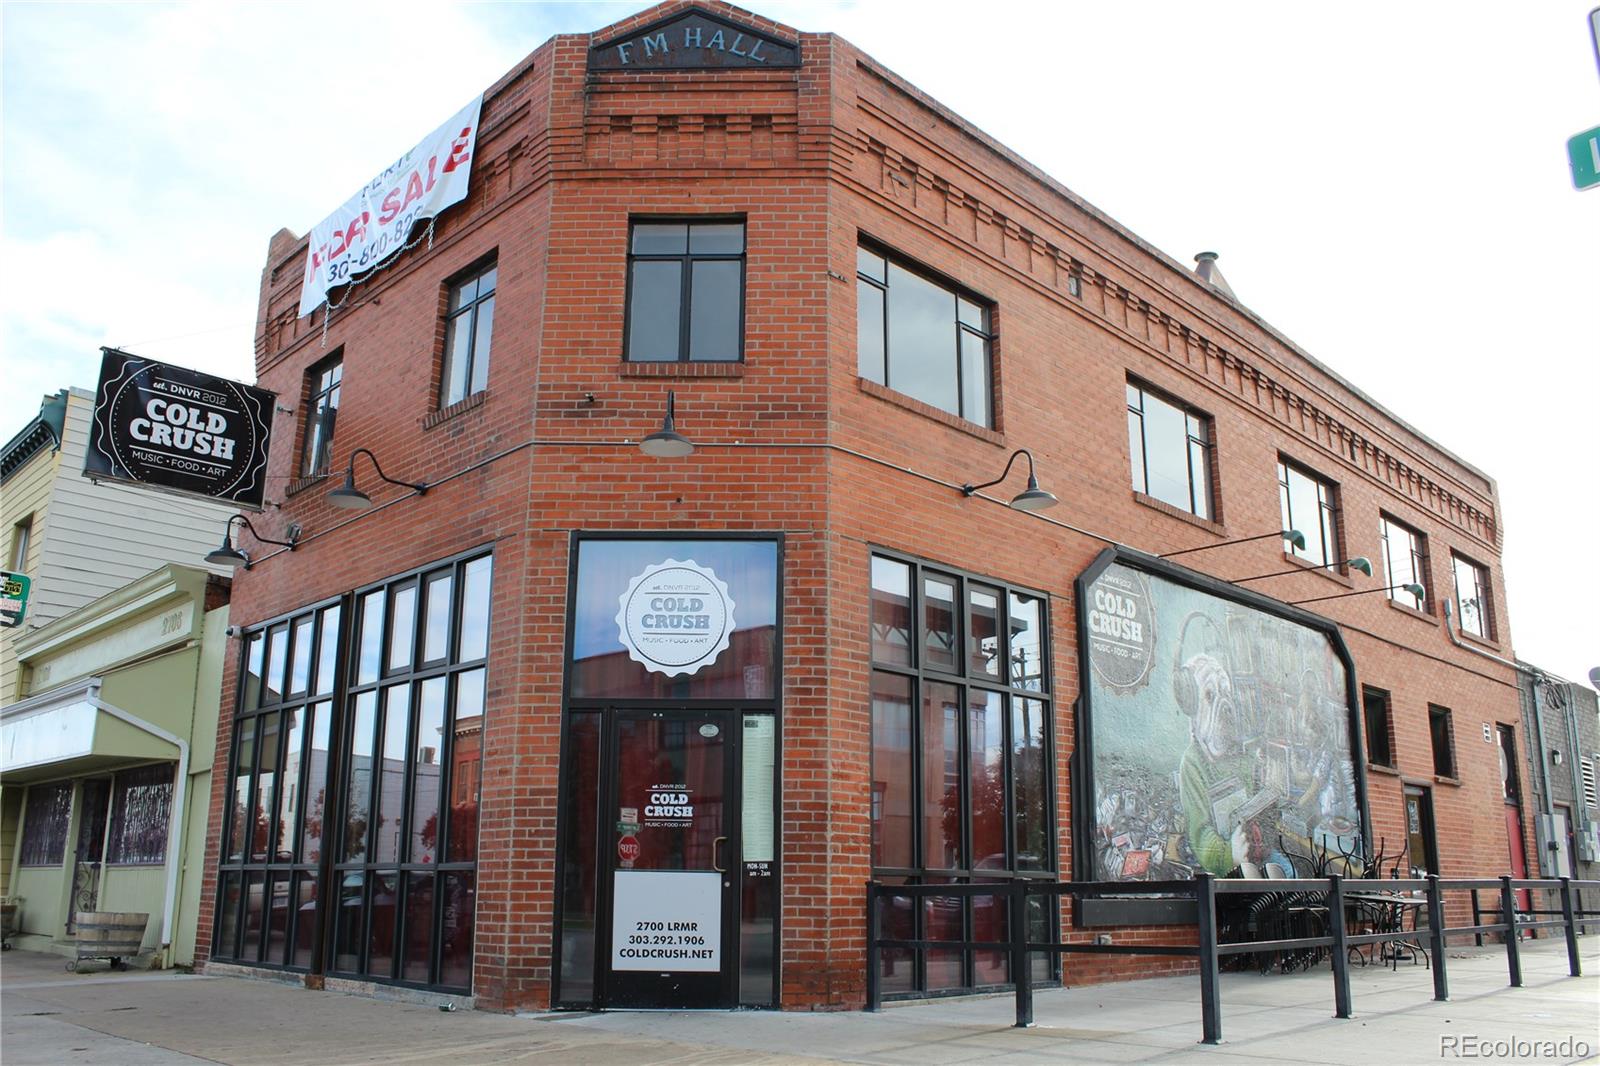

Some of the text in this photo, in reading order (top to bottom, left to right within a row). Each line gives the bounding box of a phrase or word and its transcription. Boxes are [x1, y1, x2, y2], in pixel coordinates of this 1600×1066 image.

[684, 27, 768, 63] HALL
[170, 384, 201, 399] DNVR
[202, 392, 227, 406] 2012
[146, 398, 227, 435] COLD
[129, 417, 236, 461] CRUSH
[132, 450, 227, 477] MUSIC FOOD ART
[650, 597, 704, 612] COLD
[1095, 589, 1137, 619] COLD
[641, 614, 710, 629] CRUSH
[1088, 609, 1143, 643] CRUSH
[650, 793, 689, 805] COLD
[644, 805, 694, 817] CRUSH
[636, 922, 698, 931] 2700 LRMR
[629, 935, 705, 945] 303.292.1906
[619, 949, 714, 959] COLDCRUSH.NET
